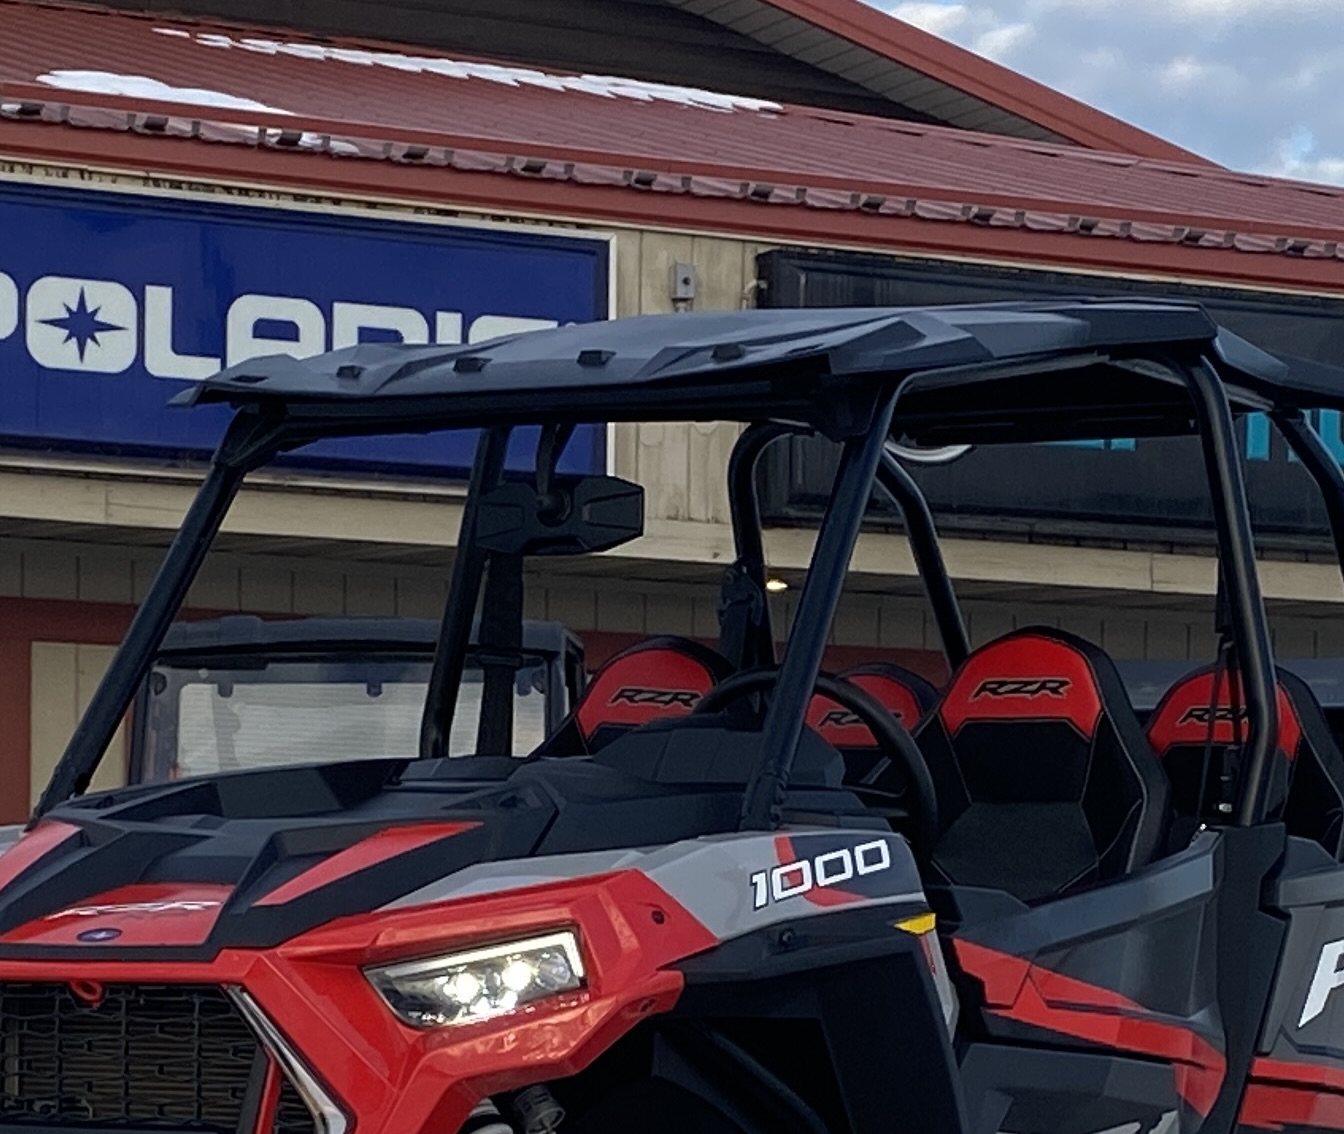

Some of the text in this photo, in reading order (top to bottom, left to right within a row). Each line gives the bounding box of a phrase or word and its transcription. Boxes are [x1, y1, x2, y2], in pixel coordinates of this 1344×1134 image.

[607, 686, 706, 708] RZR
[967, 677, 1073, 700] RZR
[751, 839, 891, 910] 1000
